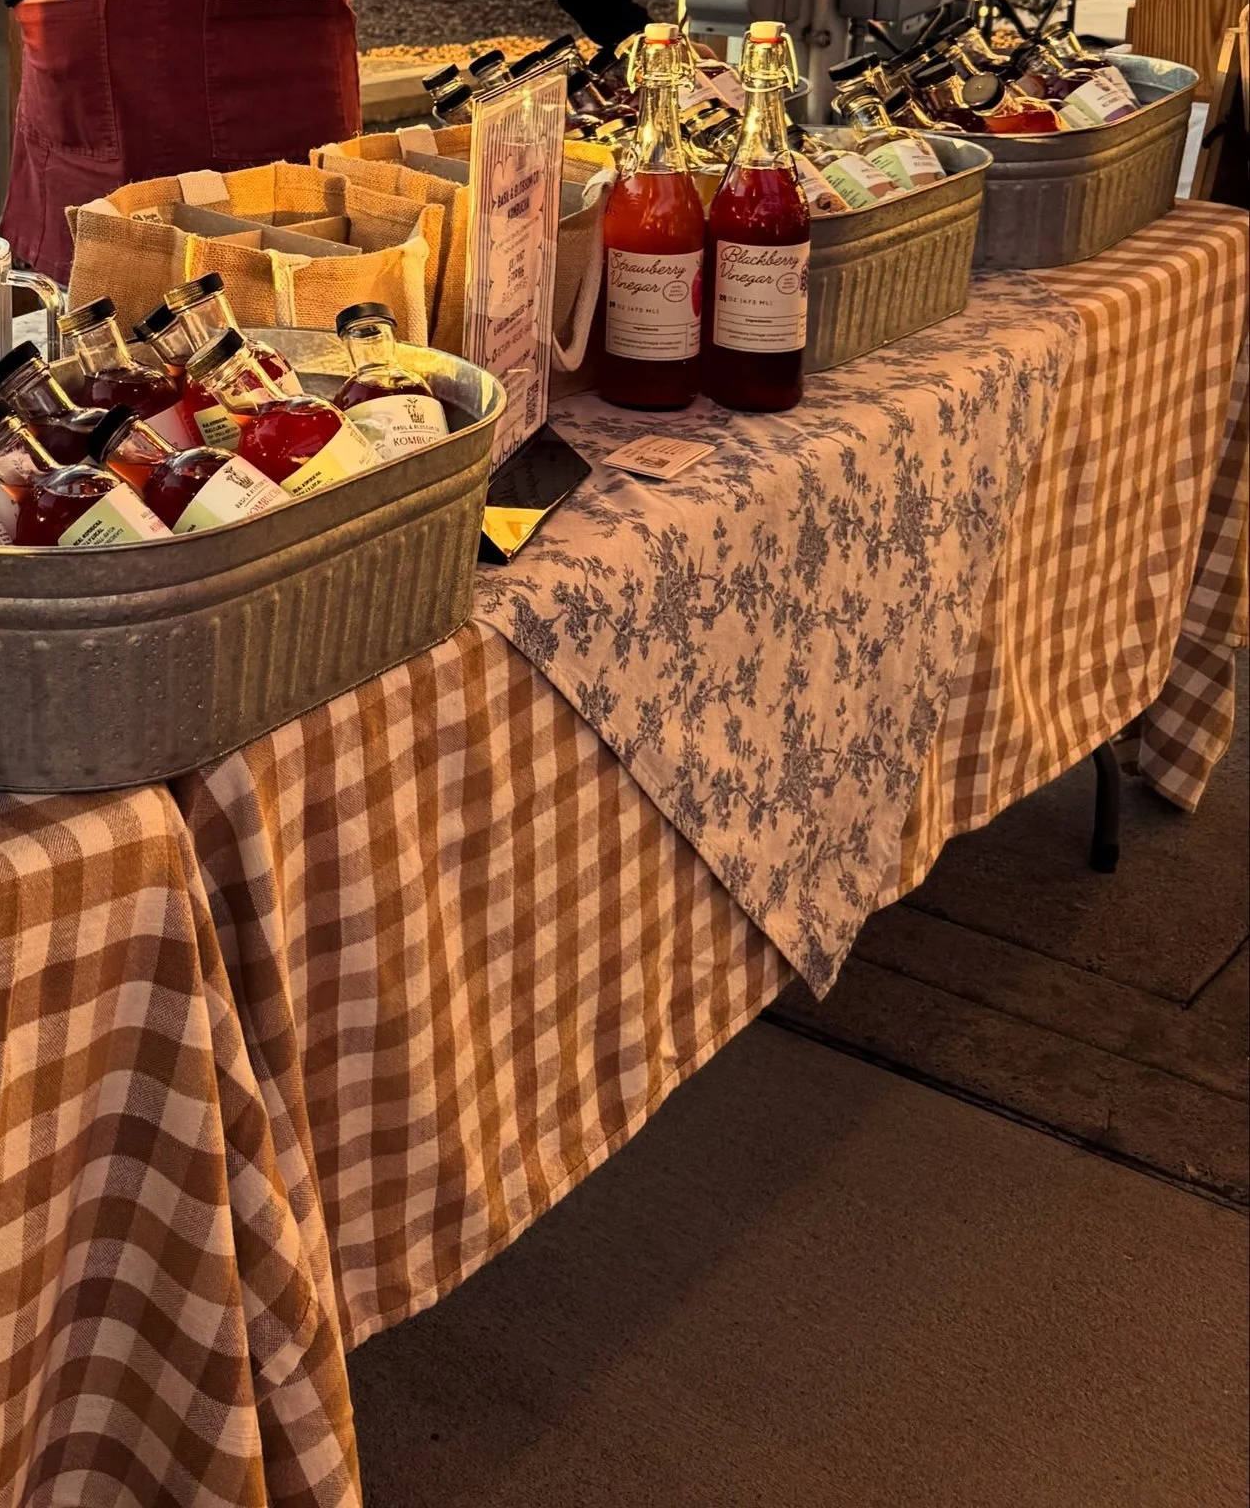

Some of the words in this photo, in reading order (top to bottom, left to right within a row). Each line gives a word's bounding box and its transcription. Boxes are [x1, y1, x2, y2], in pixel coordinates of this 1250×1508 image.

[610, 252, 687, 279] Strawberry
[720, 245, 800, 270] Blackberry
[610, 270, 660, 296] Vinegar
[720, 262, 774, 288] Vinegar
